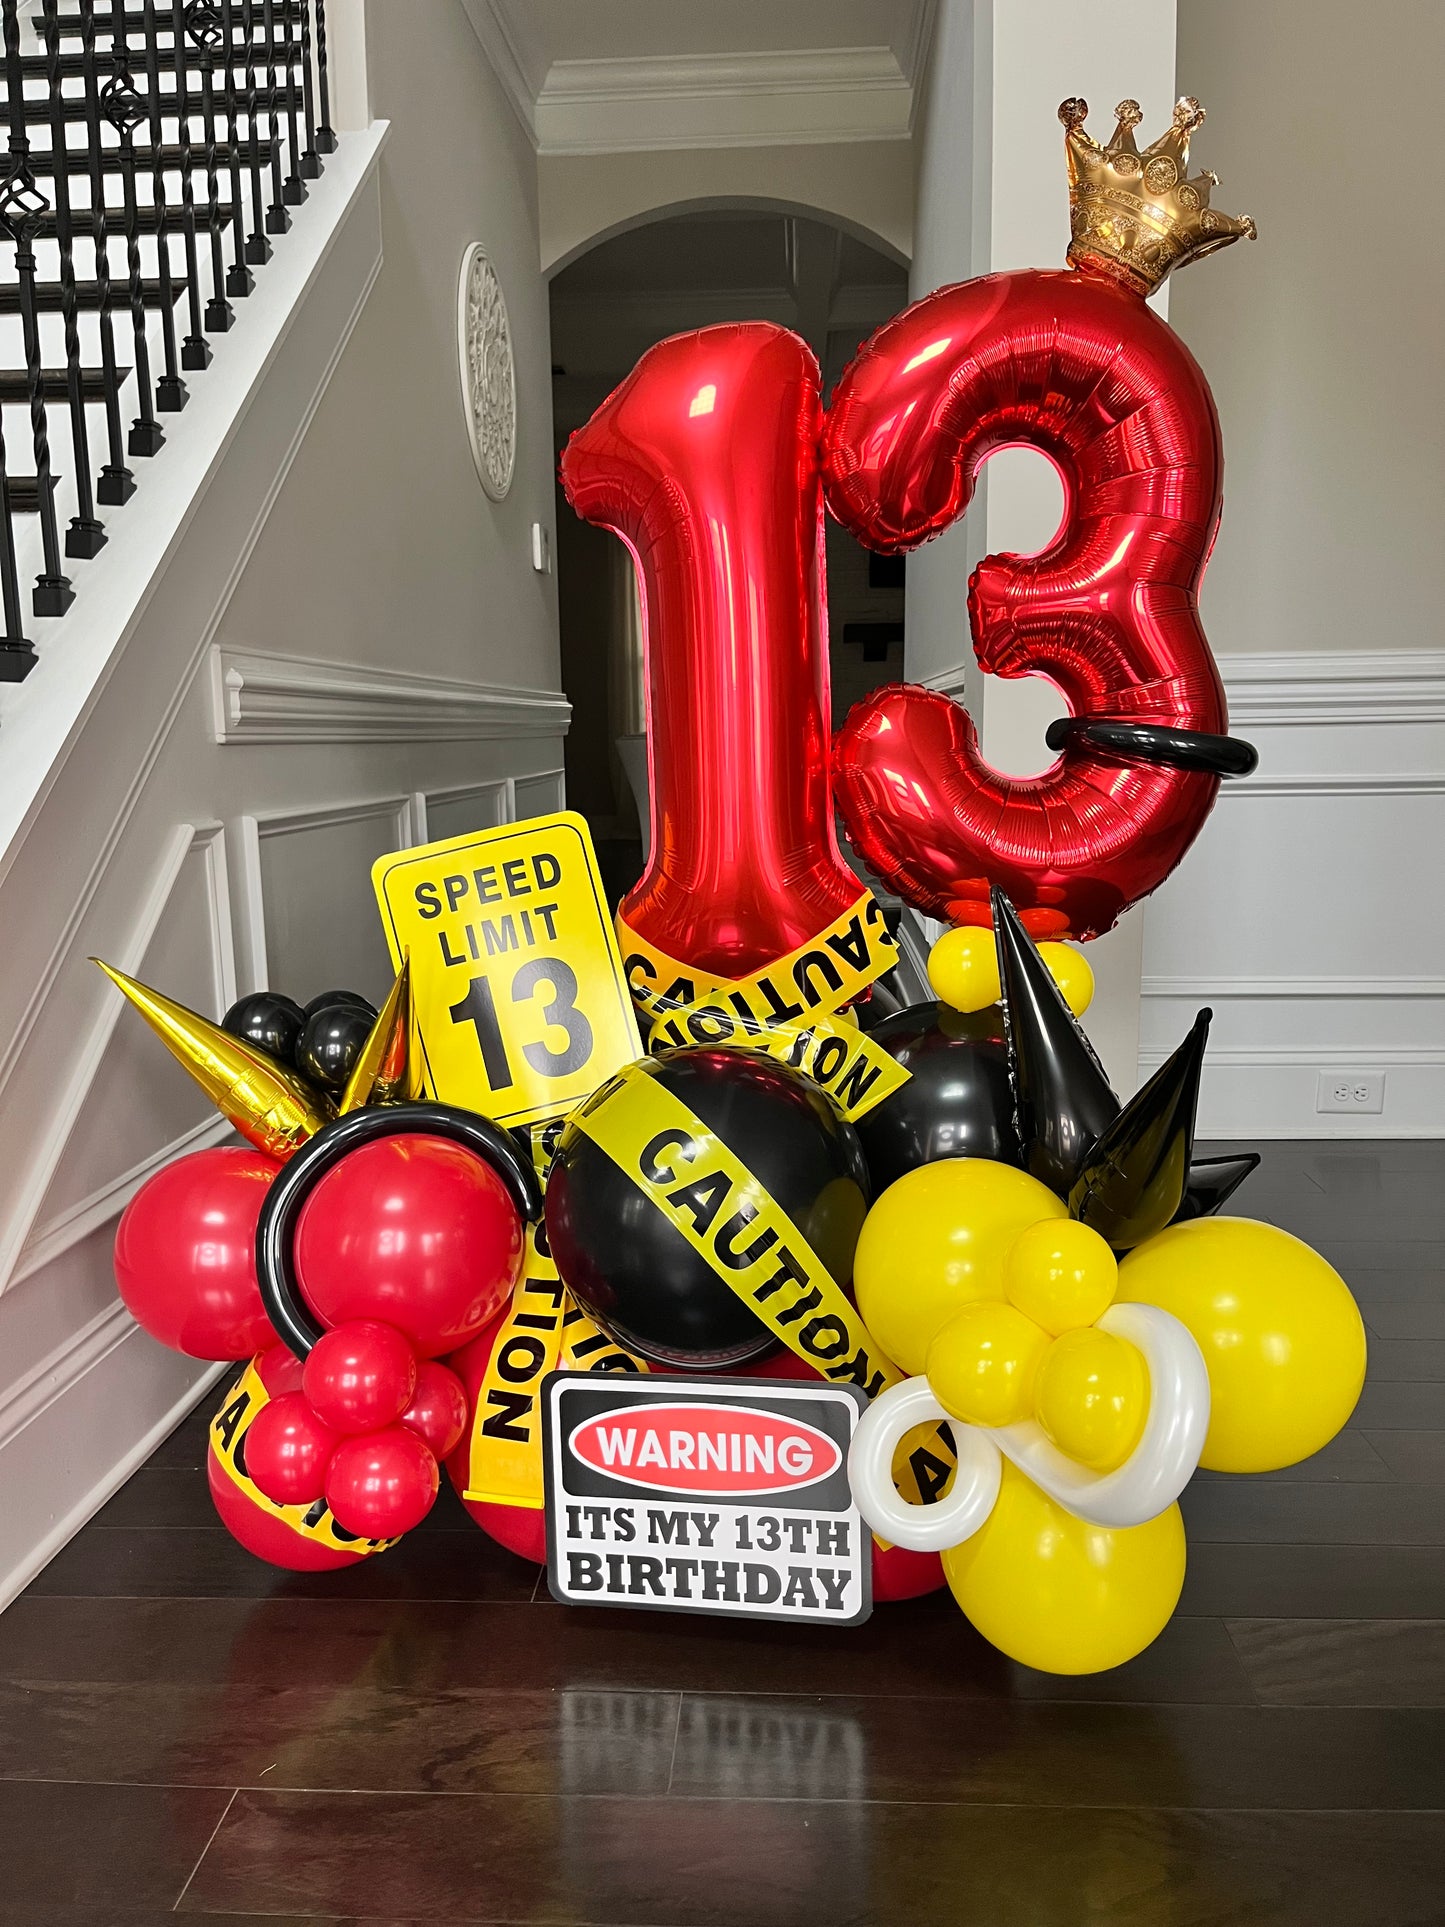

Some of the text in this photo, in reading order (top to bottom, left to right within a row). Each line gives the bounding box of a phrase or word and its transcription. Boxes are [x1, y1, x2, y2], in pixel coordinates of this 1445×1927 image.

[560, 267, 1228, 982] 13
[414, 853, 562, 919] SPEED
[438, 903, 559, 967] LIMIT
[449, 957, 594, 1092] 13
[639, 1128, 886, 1399] CAUTION
[595, 1426, 814, 1476] WARNING
[565, 1504, 851, 1557] ITS MY 13TH
[567, 1551, 852, 1611] BIRTHDAY
